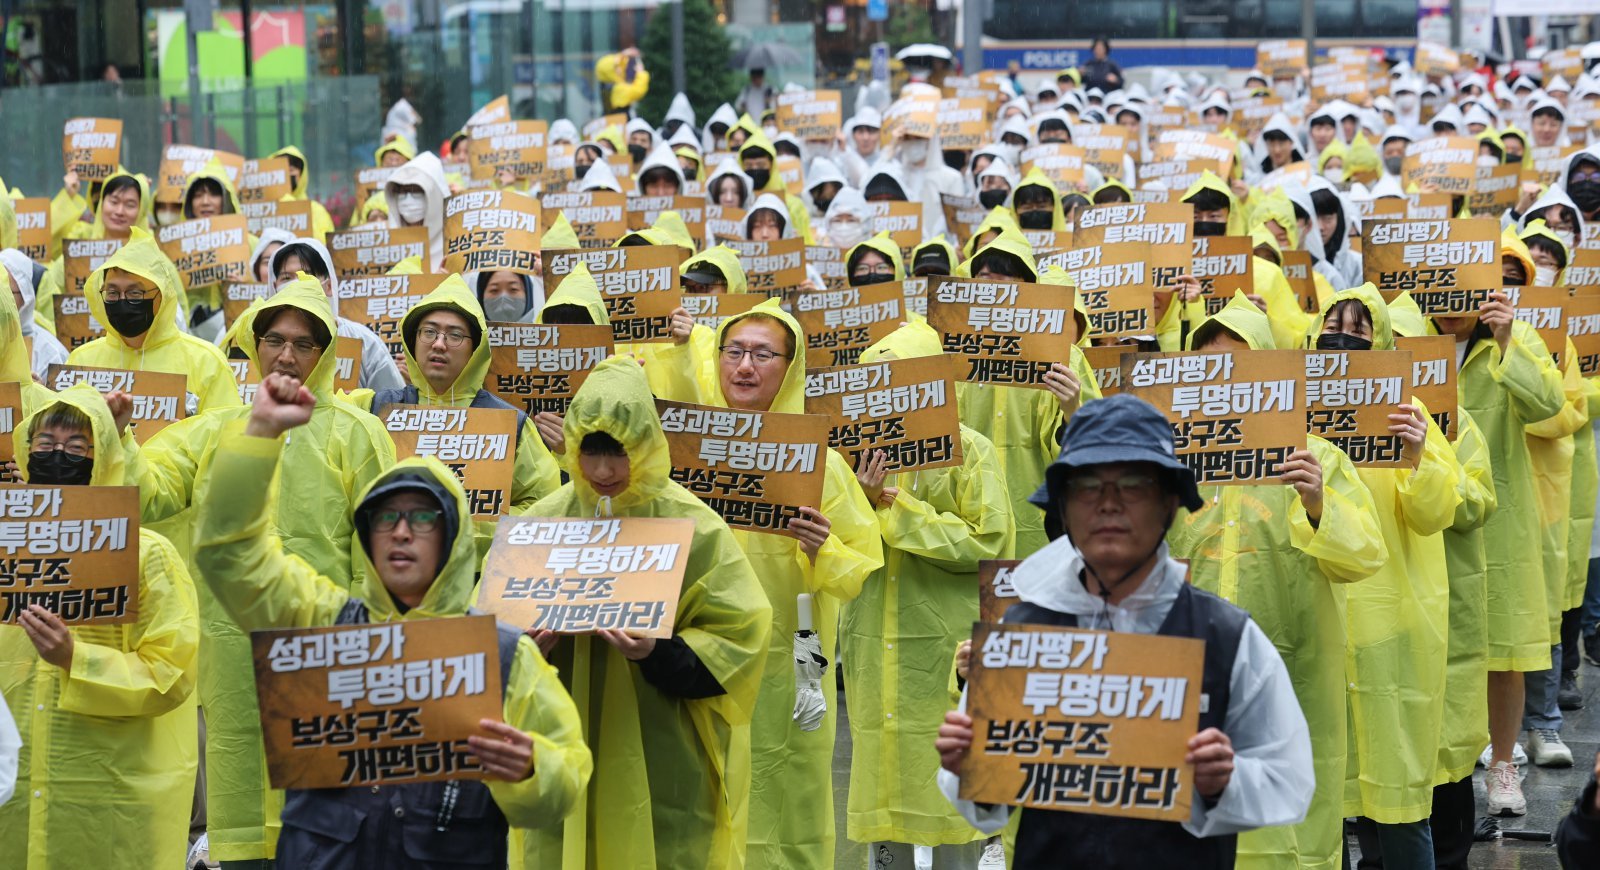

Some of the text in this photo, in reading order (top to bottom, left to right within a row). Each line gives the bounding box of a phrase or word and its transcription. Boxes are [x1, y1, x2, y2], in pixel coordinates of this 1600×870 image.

[1023, 50, 1079, 68] POLICE
[446, 191, 503, 218] 성과평가
[1079, 204, 1147, 229] 성과평가
[159, 218, 211, 243] 성과평가
[462, 208, 537, 233] 투명하게
[1103, 222, 1187, 245] 투명하게
[1370, 221, 1451, 245] 성과평가
[181, 228, 244, 255] 투명하게
[332, 230, 390, 250] 성과평가
[447, 230, 506, 255] 보상구조
[463, 249, 537, 272] 개편하라
[1191, 253, 1248, 278] 명하게
[1402, 240, 1495, 269] 투명하게
[228, 284, 268, 301] 성과평
[338, 275, 409, 299] 성과평가
[1379, 268, 1458, 291] 보상구조
[606, 296, 637, 317] 구조
[797, 288, 860, 312] 성과평가
[936, 281, 1019, 306] 성과평가
[824, 299, 899, 330] 투명하게
[967, 307, 1066, 335] 투명하게
[1089, 307, 1148, 335] 편하라
[487, 326, 560, 348] 성과평가
[610, 316, 673, 342] 편하라
[808, 327, 871, 349] 보상구조
[943, 332, 1023, 358] 보상구조
[1131, 354, 1235, 387] 성과평가
[1306, 353, 1350, 378] 평가
[496, 374, 572, 396] 보상구조
[804, 362, 893, 398] 성과평가
[132, 395, 178, 421] 하게
[841, 378, 947, 422] 투명하게
[1171, 379, 1297, 418] 투명하게
[386, 409, 467, 432] 성과평가
[660, 406, 764, 439] 성과평가
[1172, 418, 1244, 450] 상구조
[414, 433, 511, 461] 투명하게
[698, 437, 819, 474] 투명하게
[0, 488, 62, 518] 평가
[507, 519, 621, 546] 성과평가
[0, 557, 72, 588] 상구조
[544, 543, 681, 576] 투명하게
[501, 576, 619, 601] 보상구조
[530, 601, 666, 631] 개편하라
[267, 624, 406, 673] 성과평가
[982, 631, 1109, 671] 성과평가
[326, 652, 487, 709] 투명하게
[1022, 671, 1189, 721] 투명하게
[291, 706, 424, 748] 보상구조
[984, 719, 1113, 759] 보상구조
[1015, 762, 1181, 812] 개편하라
